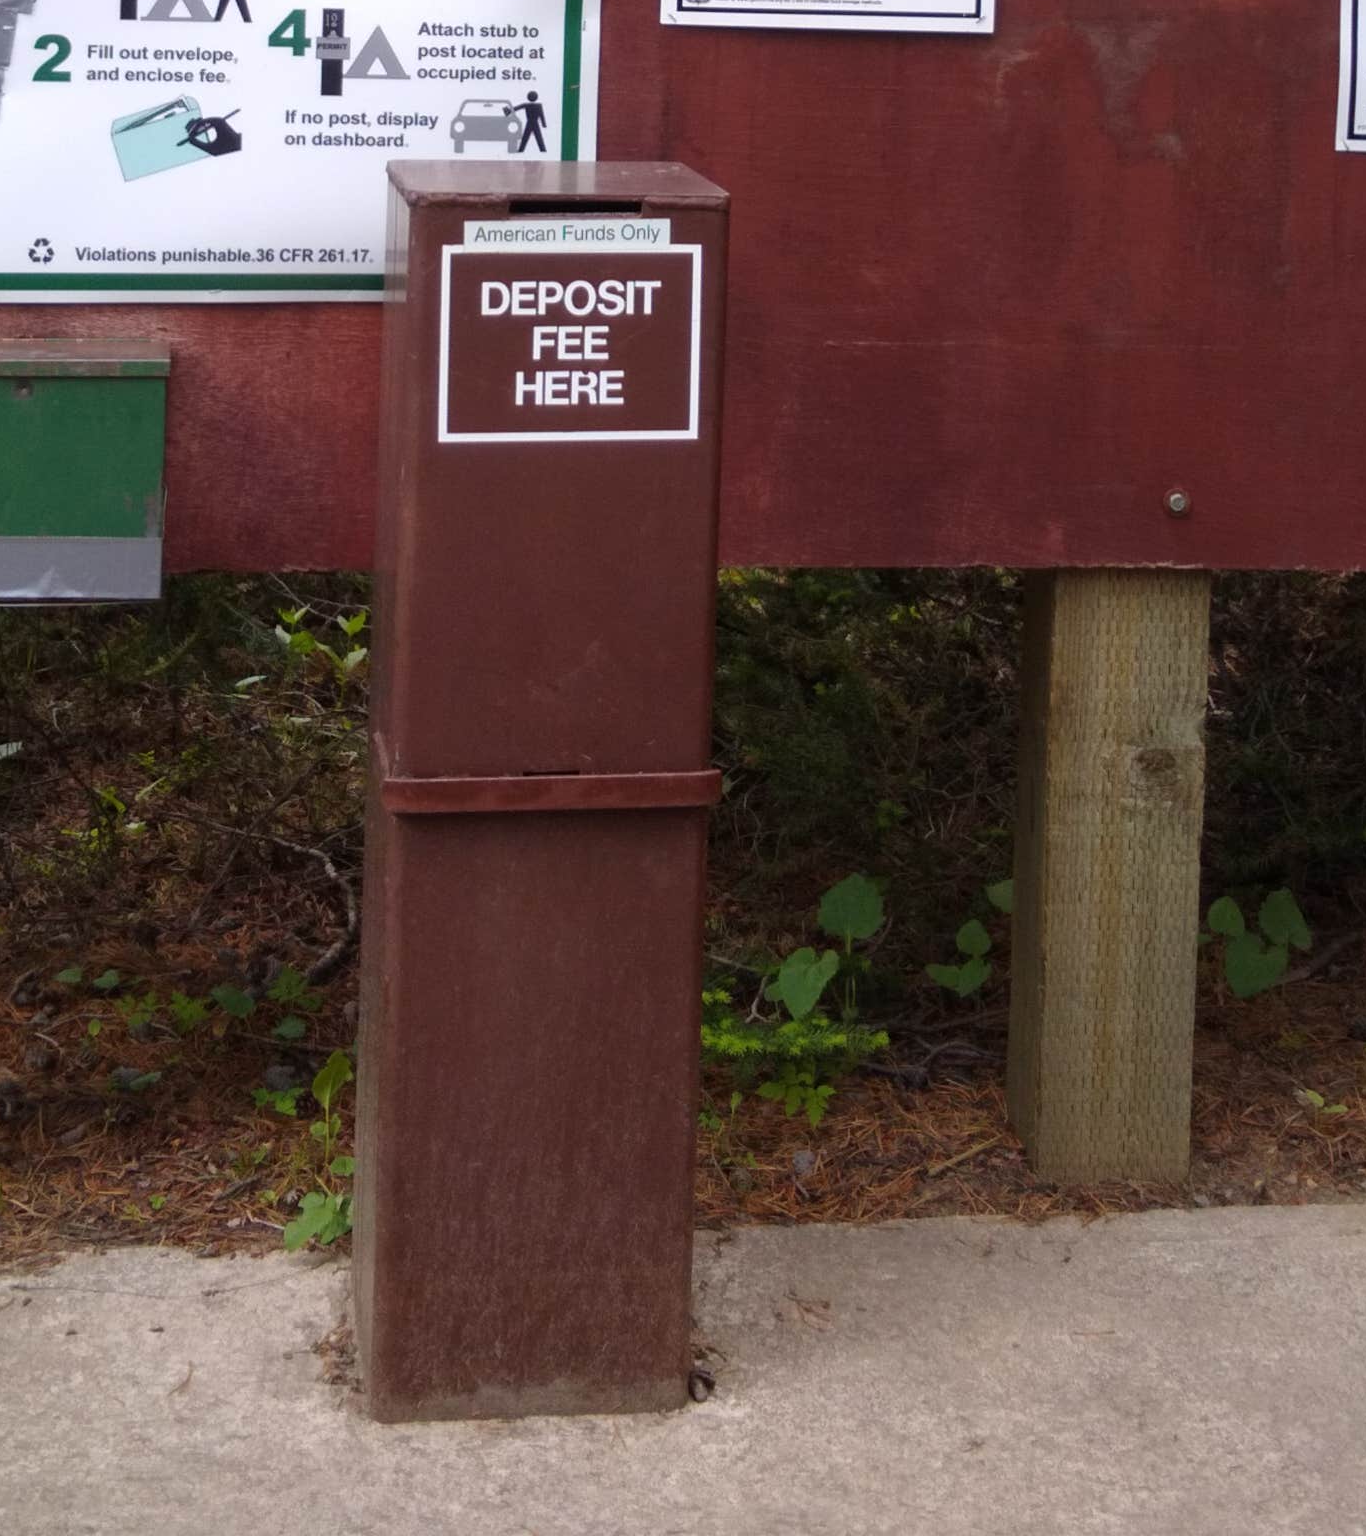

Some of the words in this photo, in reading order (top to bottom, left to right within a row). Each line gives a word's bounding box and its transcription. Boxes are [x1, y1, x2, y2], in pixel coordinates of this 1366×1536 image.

[268, 9, 311, 56] 4
[418, 22, 473, 36] Attach
[480, 24, 517, 37] stub
[522, 25, 538, 38] to
[87, 44, 113, 58] Fill
[119, 47, 147, 59] out
[153, 48, 237, 63] envelope,
[316, 41, 347, 51] PERMIT
[418, 45, 455, 60] post
[462, 45, 523, 58] located
[529, 47, 544, 59] at
[32, 32, 72, 84] 2
[86, 67, 118, 80] and
[125, 69, 193, 82] enclose
[199, 68, 230, 82] fee.
[417, 66, 495, 82] occupied
[501, 67, 535, 80] site.
[285, 110, 296, 123] If
[302, 113, 322, 124] no
[329, 113, 370, 127] post,
[377, 112, 438, 129] display
[284, 135, 305, 145] on
[311, 133, 407, 146] dashboard.
[474, 226, 555, 241] American
[562, 225, 614, 240] Funds
[621, 224, 660, 243] Only
[75, 247, 156, 261] Violations
[279, 248, 313, 262] CFR
[481, 280, 661, 315] DEPOSIT
[532, 326, 608, 360] FEE
[513, 369, 626, 407] HERE
